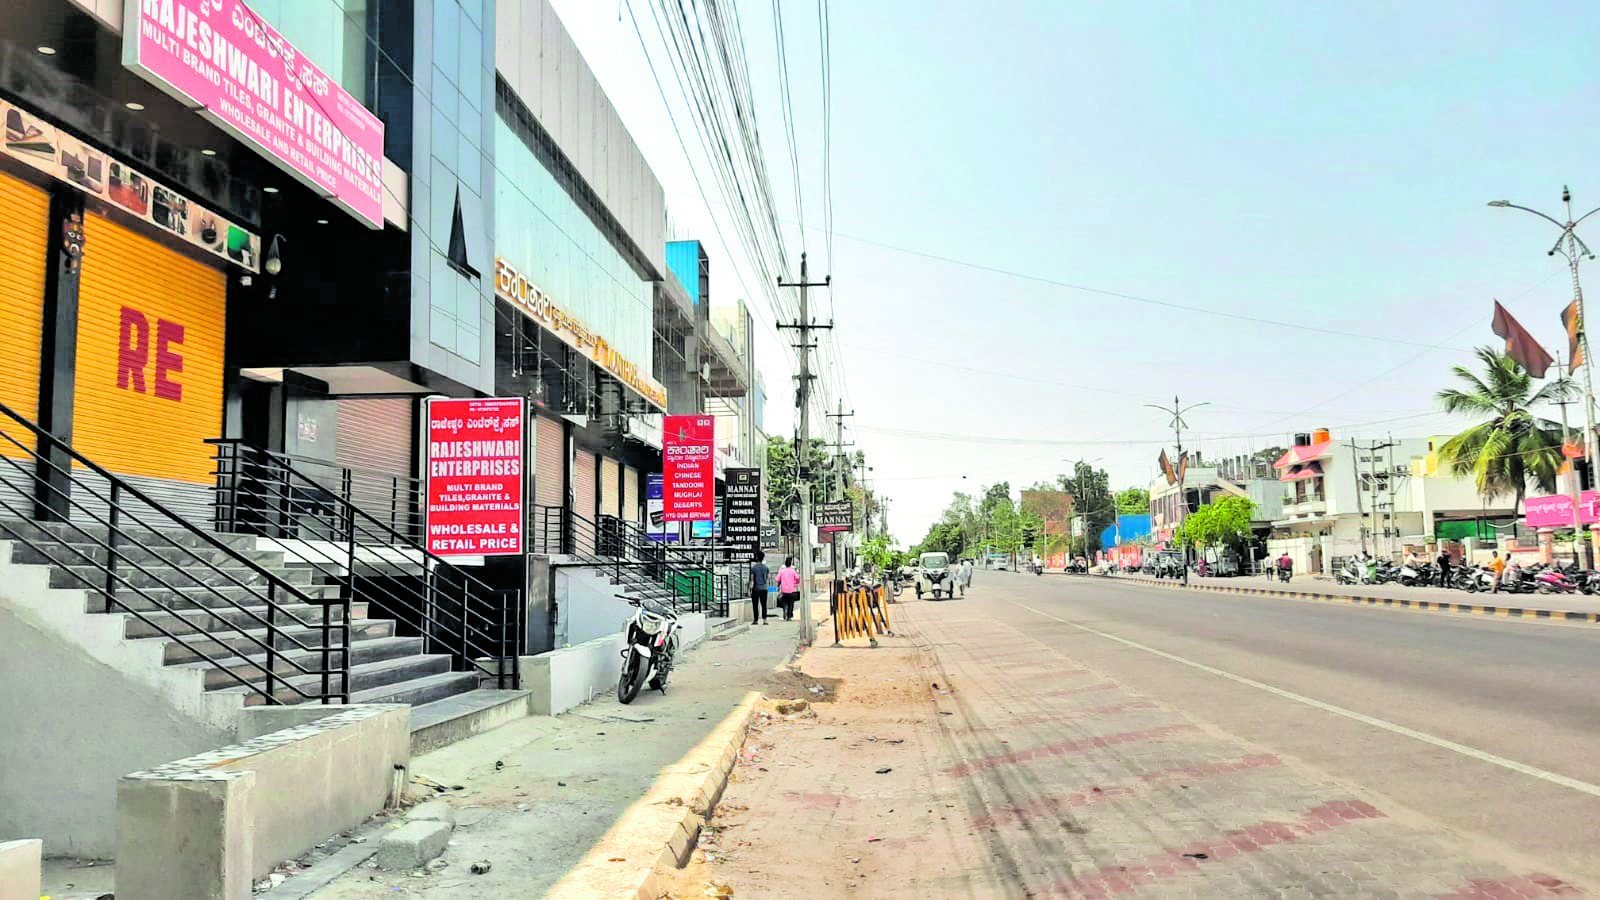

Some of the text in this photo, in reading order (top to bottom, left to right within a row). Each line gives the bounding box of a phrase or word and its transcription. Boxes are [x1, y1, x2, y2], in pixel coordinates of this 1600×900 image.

[143, 19, 180, 58] MULTI
[183, 48, 221, 86] BRAND
[223, 78, 254, 113] TILES,
[256, 100, 296, 141] GRANITE
[297, 132, 305, 148] &
[306, 138, 342, 176] BUILDING
[343, 166, 381, 204] MATERIALS
[219, 97, 337, 189] WHOLESALE AND RETAIL PRICE
[284, 87, 381, 188] ENTERPRISES
[117, 305, 185, 403] RE
[431, 440, 520, 459] RAJESHWARI
[431, 459, 520, 477] ENTERPRISES
[446, 483, 504, 492] MULTI BRAND
[727, 485, 758, 493] MANNAT
[503, 493, 511, 501] &
[430, 503, 520, 512] BUILDING MATERIALS
[816, 516, 850, 524] MANNAT
[430, 523, 519, 535] WHOLESALE &
[432, 538, 518, 550] RETAIL PRICE
